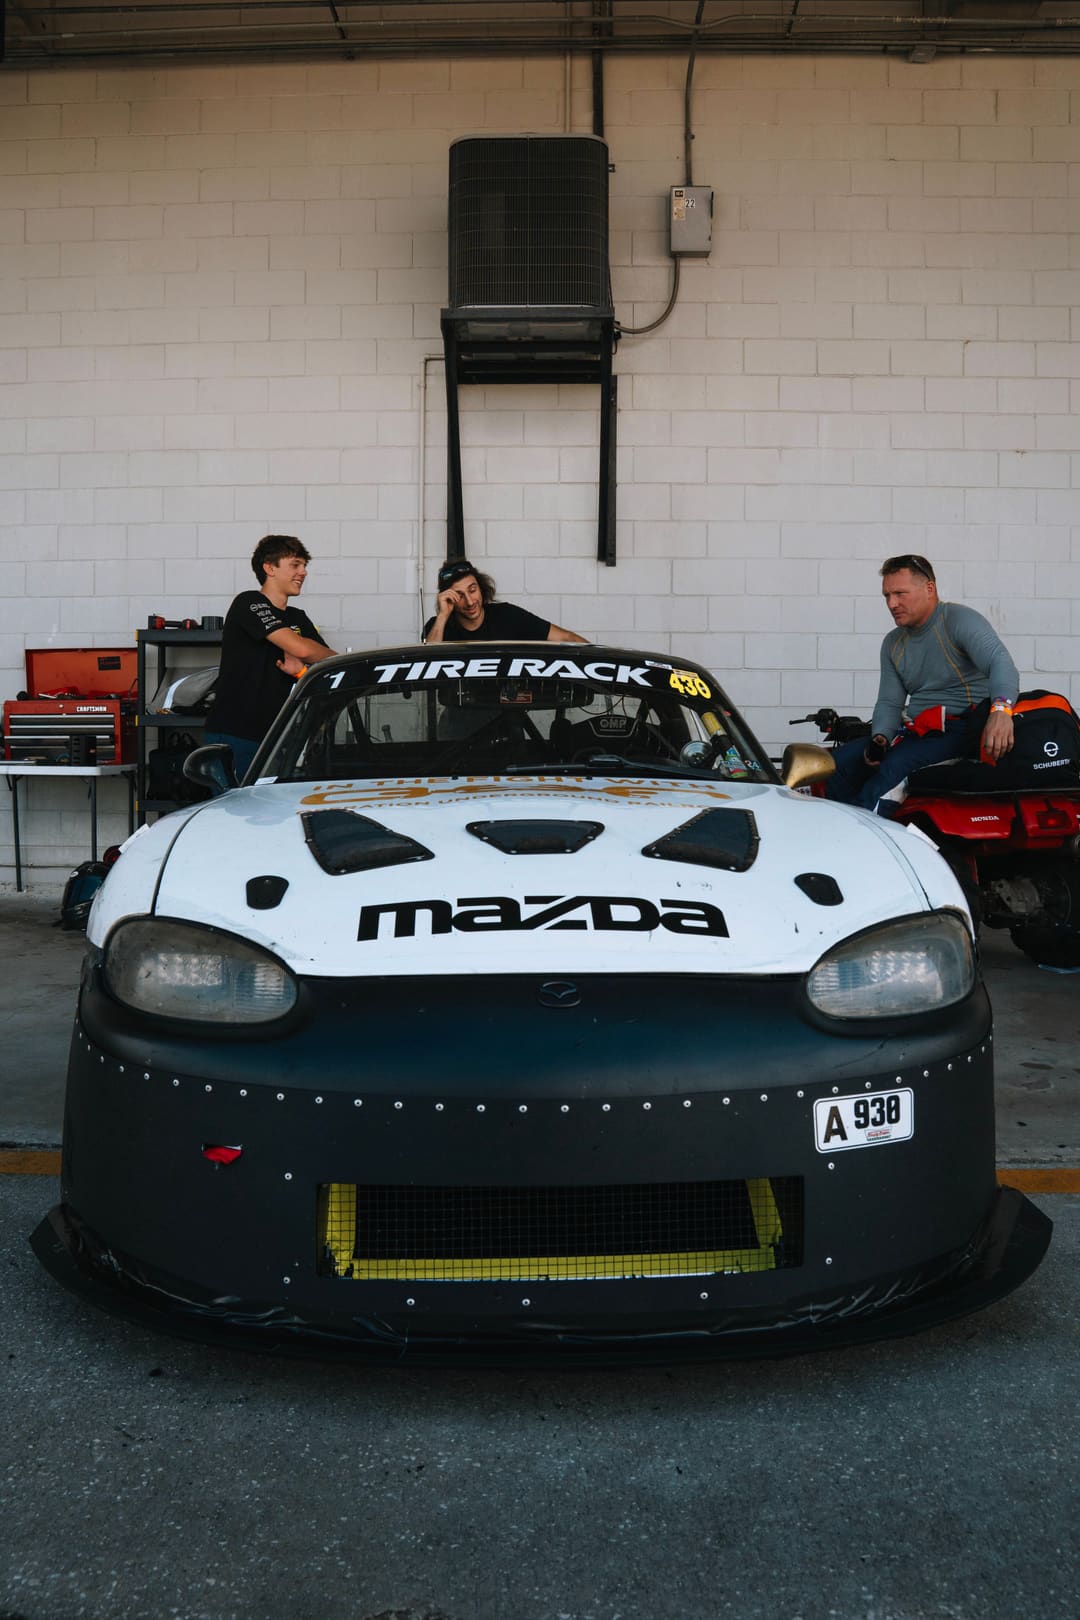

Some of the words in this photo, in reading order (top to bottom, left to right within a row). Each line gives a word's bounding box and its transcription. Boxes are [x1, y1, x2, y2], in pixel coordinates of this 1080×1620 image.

[685, 199, 696, 208] 22
[374, 658, 502, 684] TIRE
[506, 658, 653, 687] RACK
[669, 673, 712, 699] 430
[600, 718, 626, 729] OMP
[312, 783, 354, 791] IN
[370, 778, 451, 786] THE
[466, 775, 584, 783] FIGHT
[605, 778, 717, 790] WITH
[970, 815, 1000, 823] HONDA
[823, 1105, 848, 1143] A
[854, 1095, 900, 1129] 930
